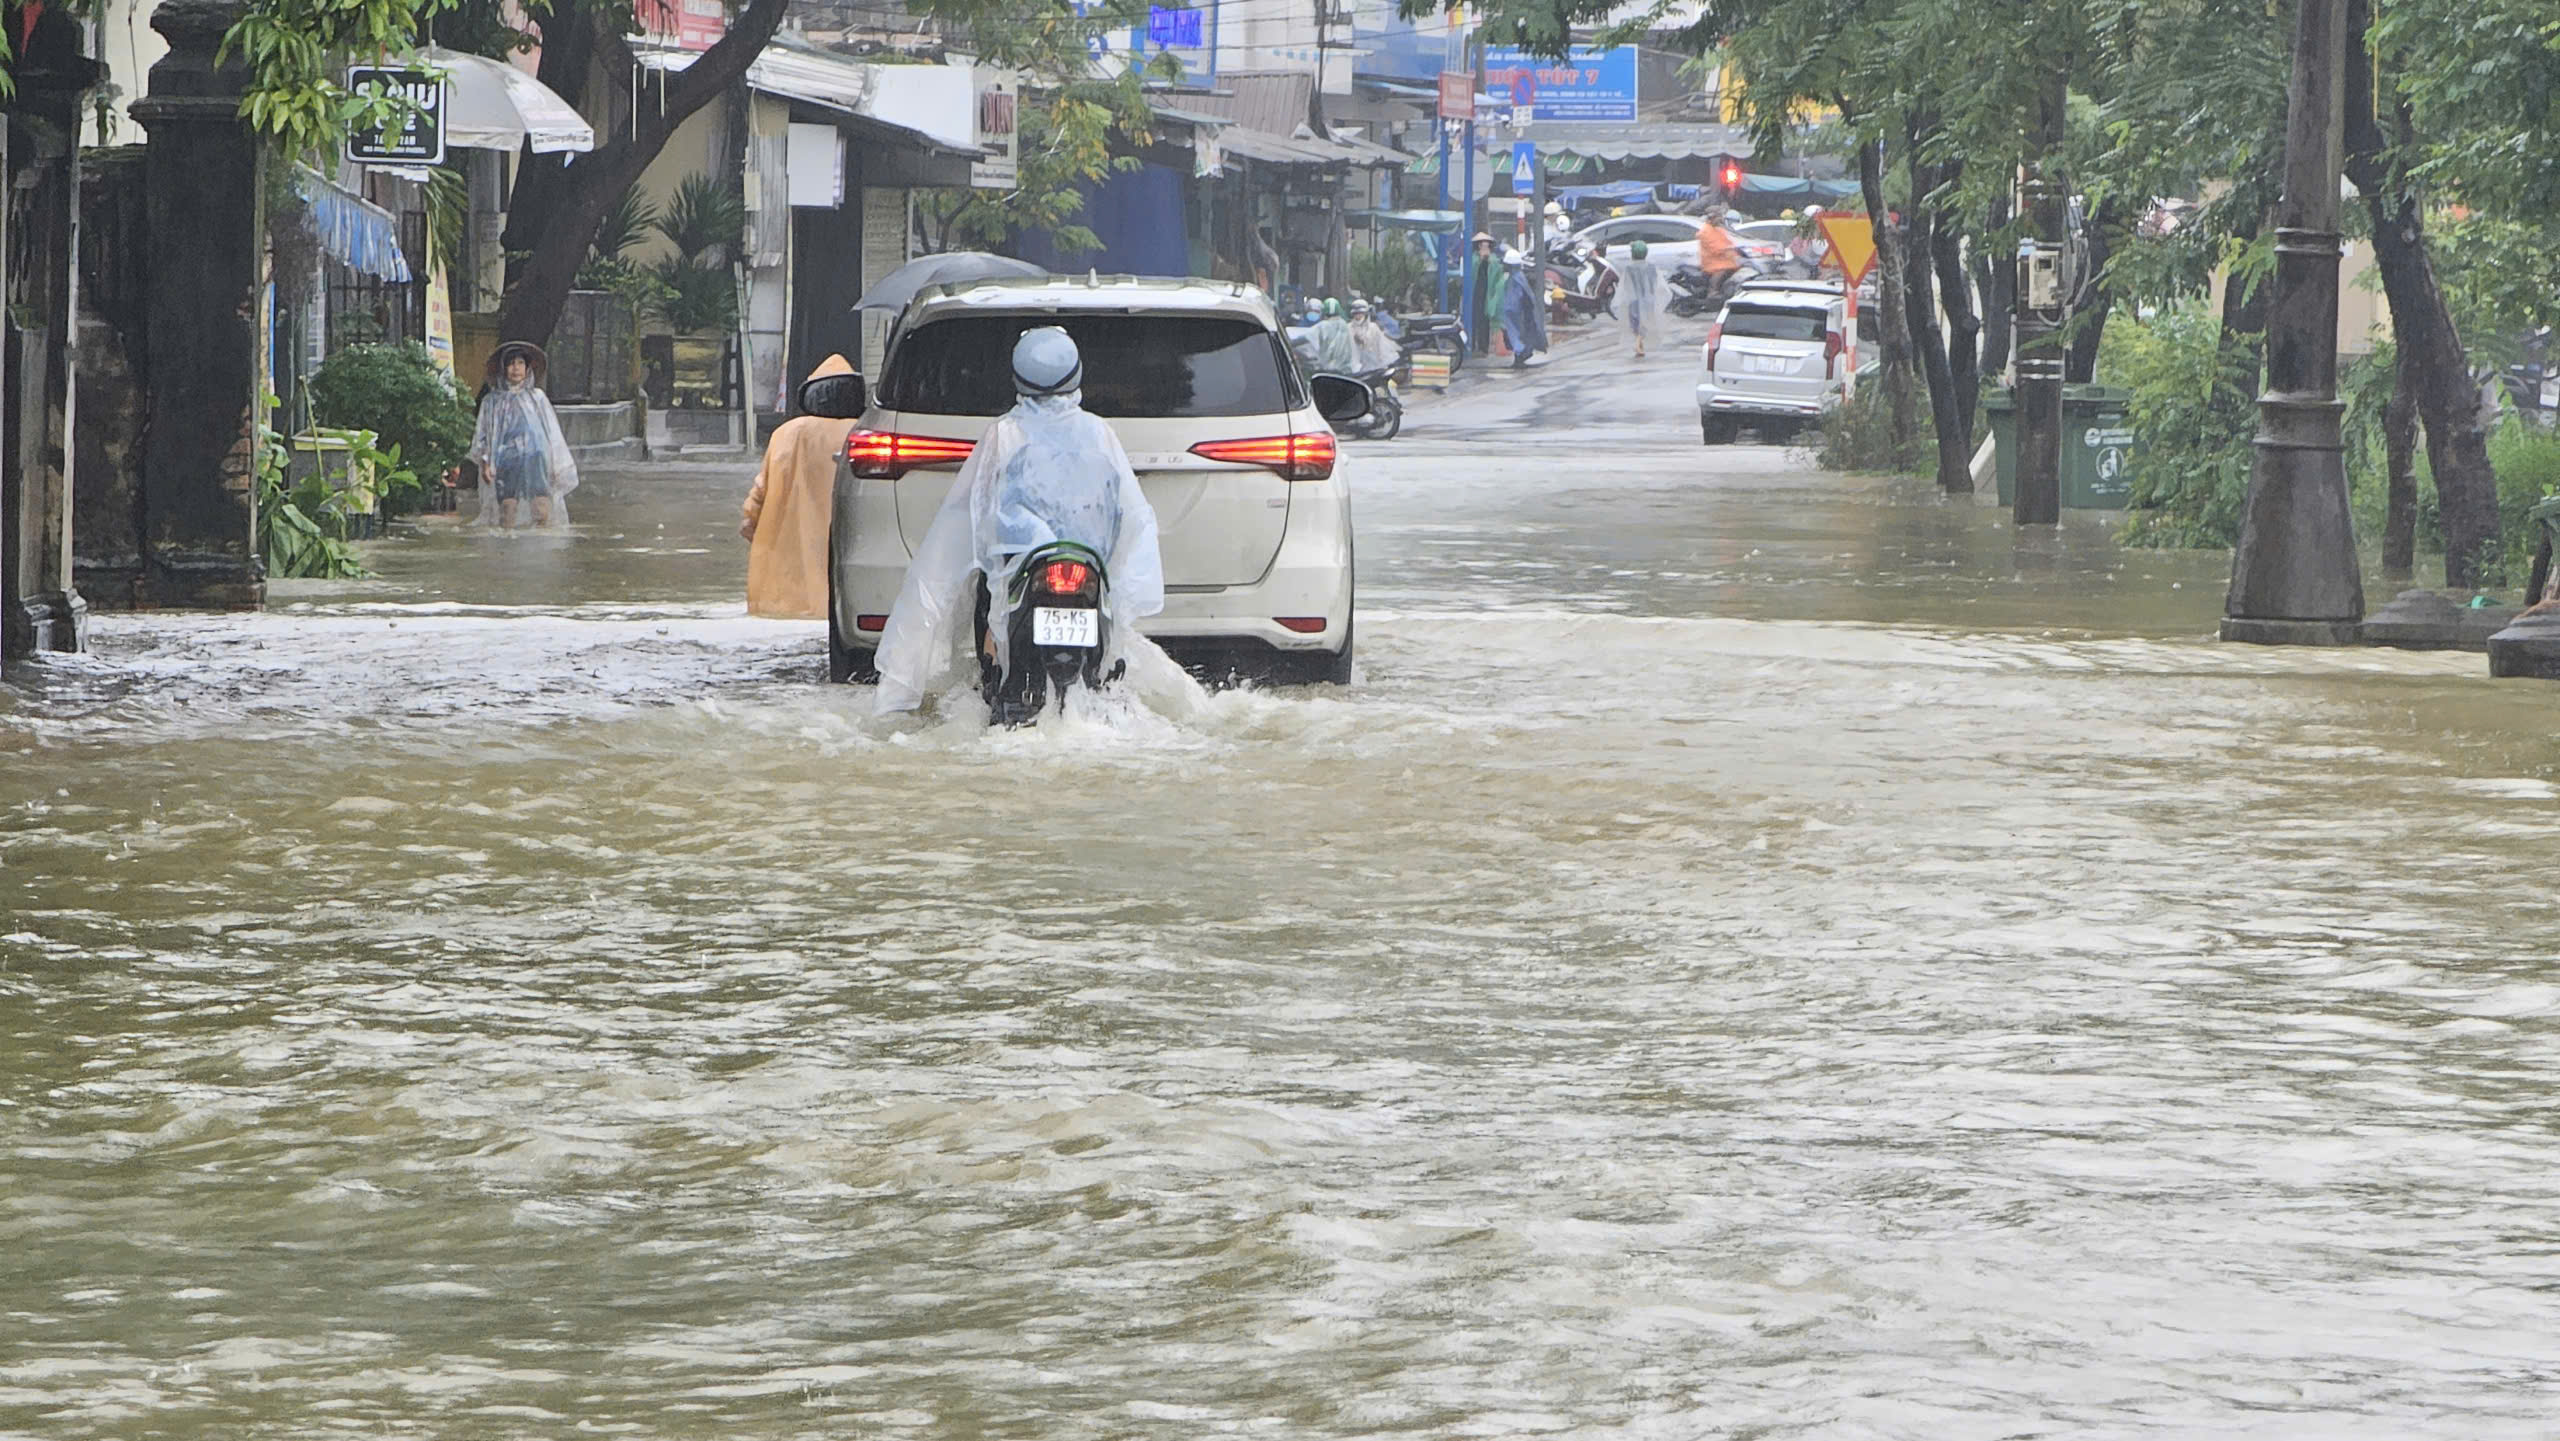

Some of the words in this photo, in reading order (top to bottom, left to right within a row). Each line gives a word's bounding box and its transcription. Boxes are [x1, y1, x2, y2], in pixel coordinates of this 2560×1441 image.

[1585, 68, 1599, 85] 7
[1043, 610, 1088, 626] 75-K5
[1042, 627, 1088, 643] 3377
